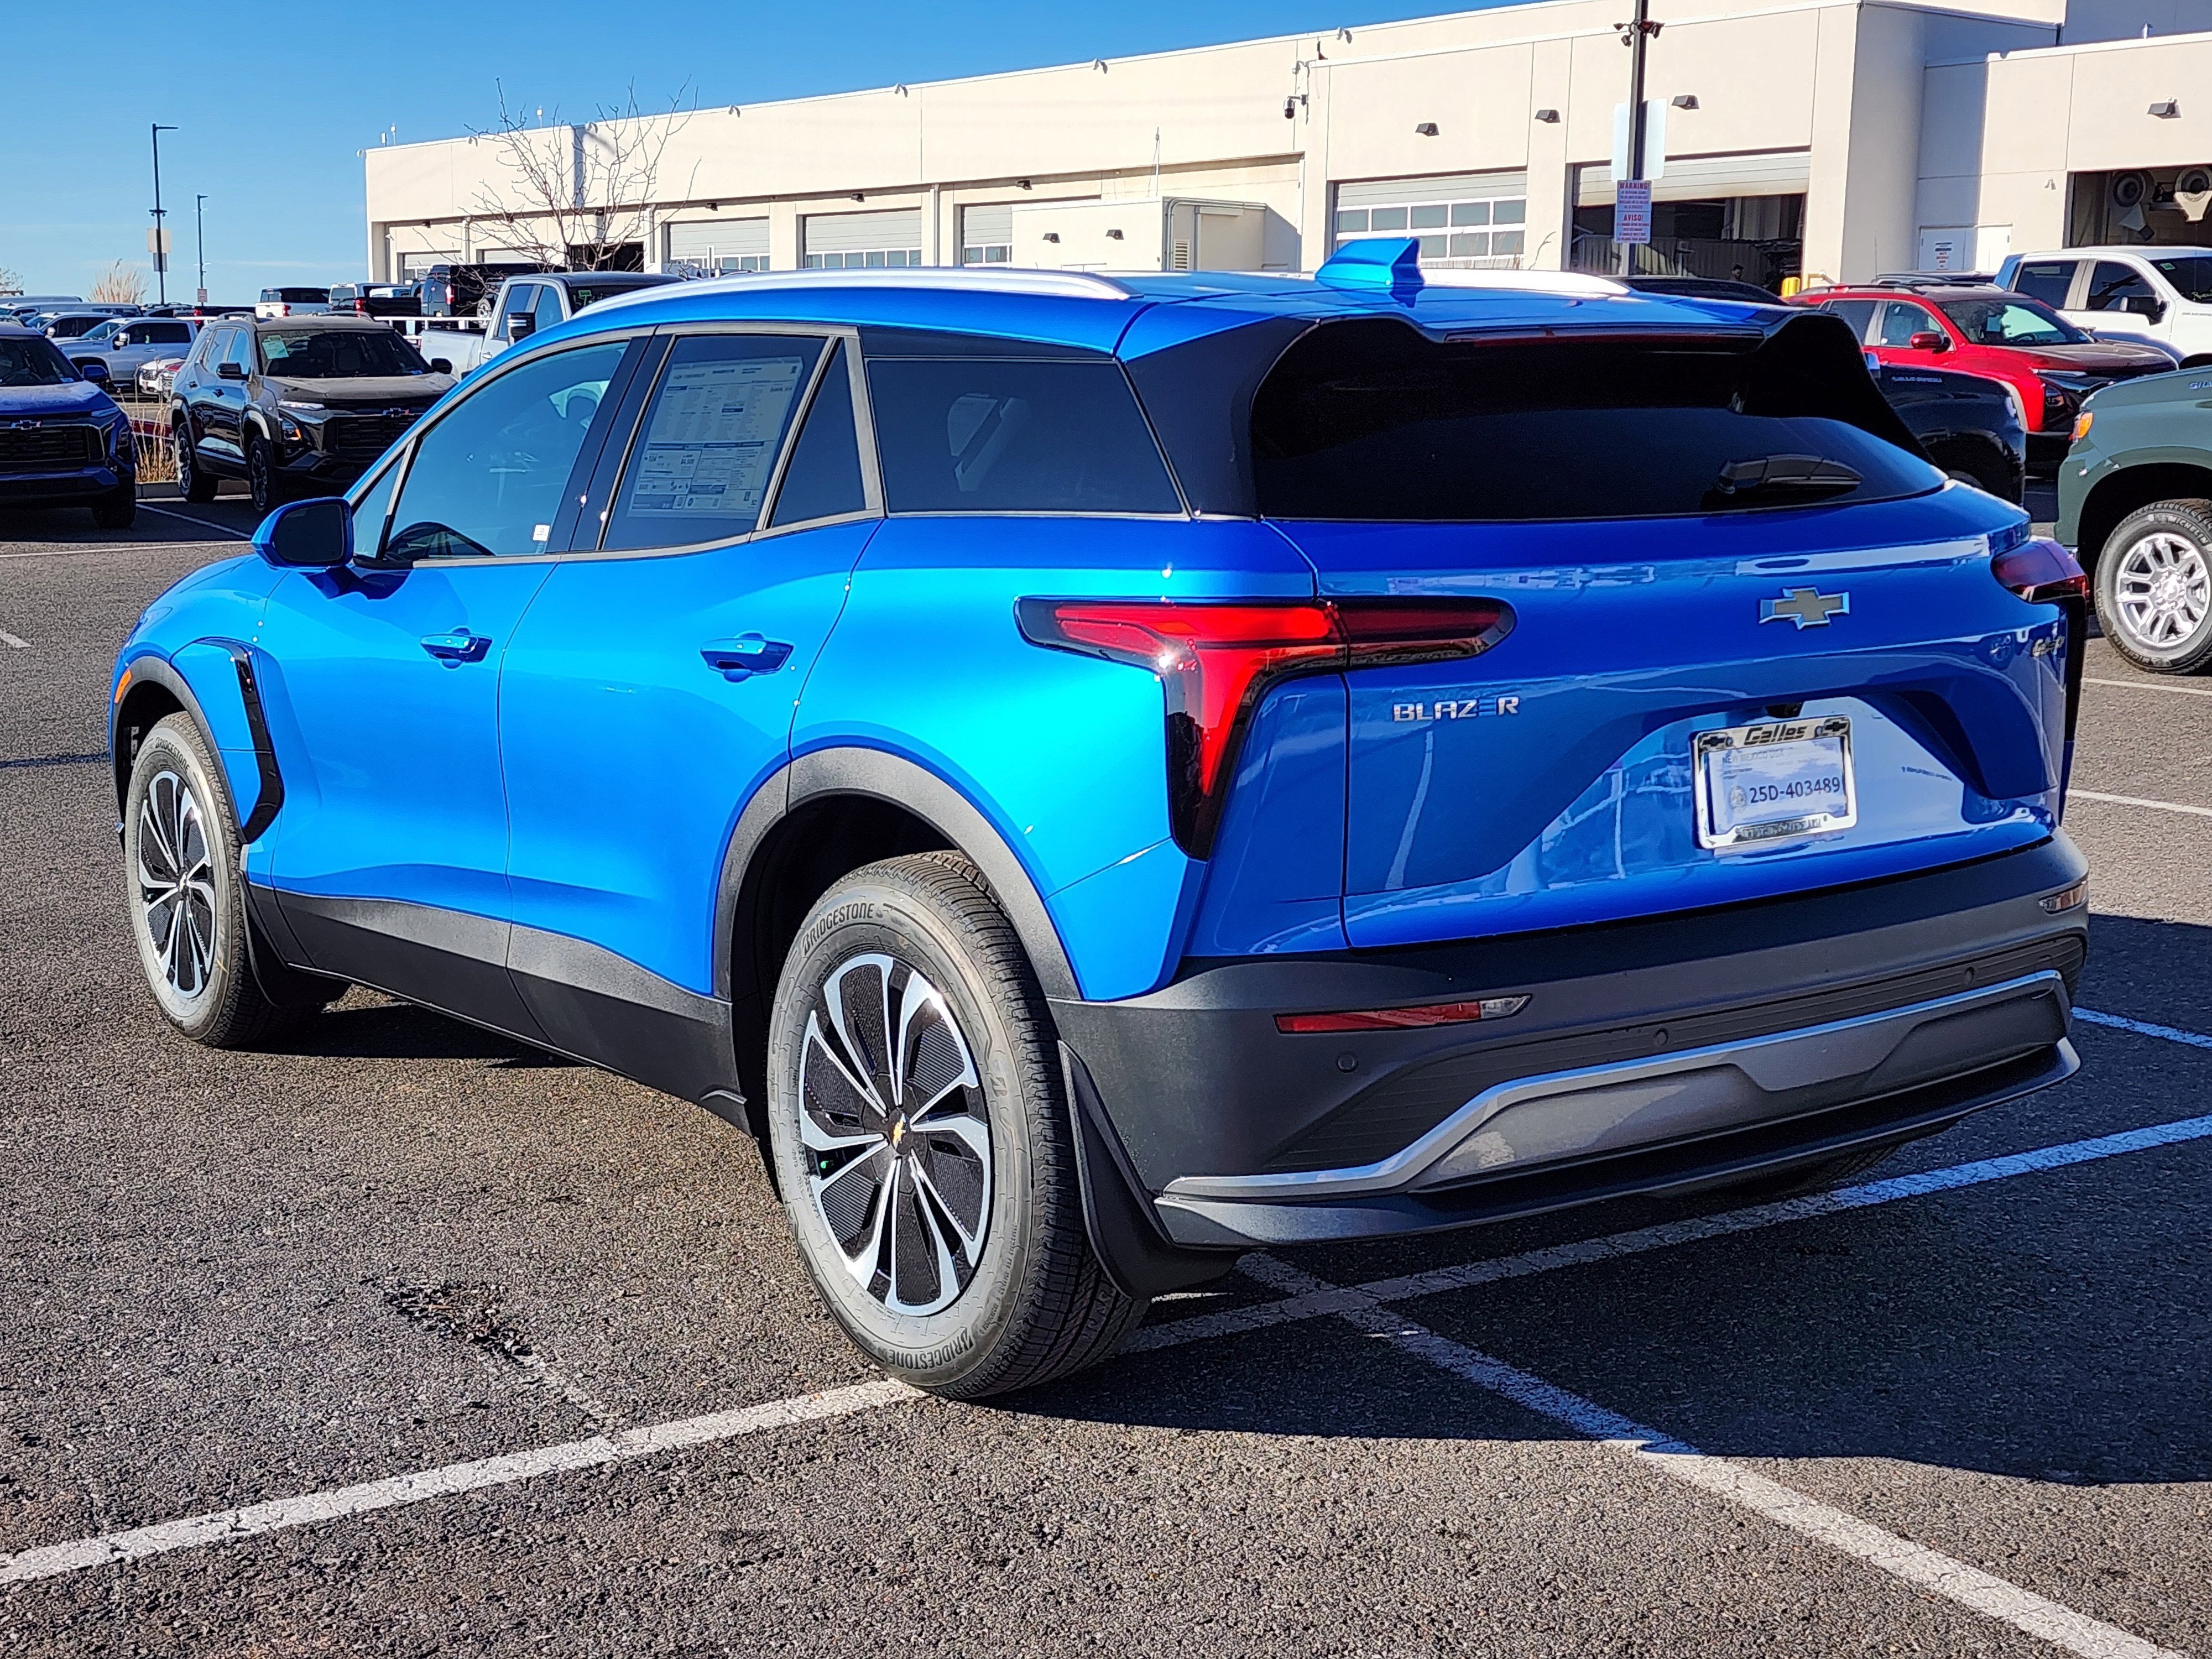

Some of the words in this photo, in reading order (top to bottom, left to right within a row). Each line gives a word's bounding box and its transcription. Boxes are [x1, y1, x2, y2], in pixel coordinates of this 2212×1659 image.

[2168, 515, 2209, 544] MICHELIN
[1393, 696, 1520, 722] BLAZER
[1743, 724, 1808, 746] Galles
[155, 737, 190, 772] BRIDGESTONE
[1749, 776, 1840, 804] 25D-403489
[802, 902, 875, 957] BRIDGESTONE
[888, 1327, 974, 1370] BRIDGESTONE
